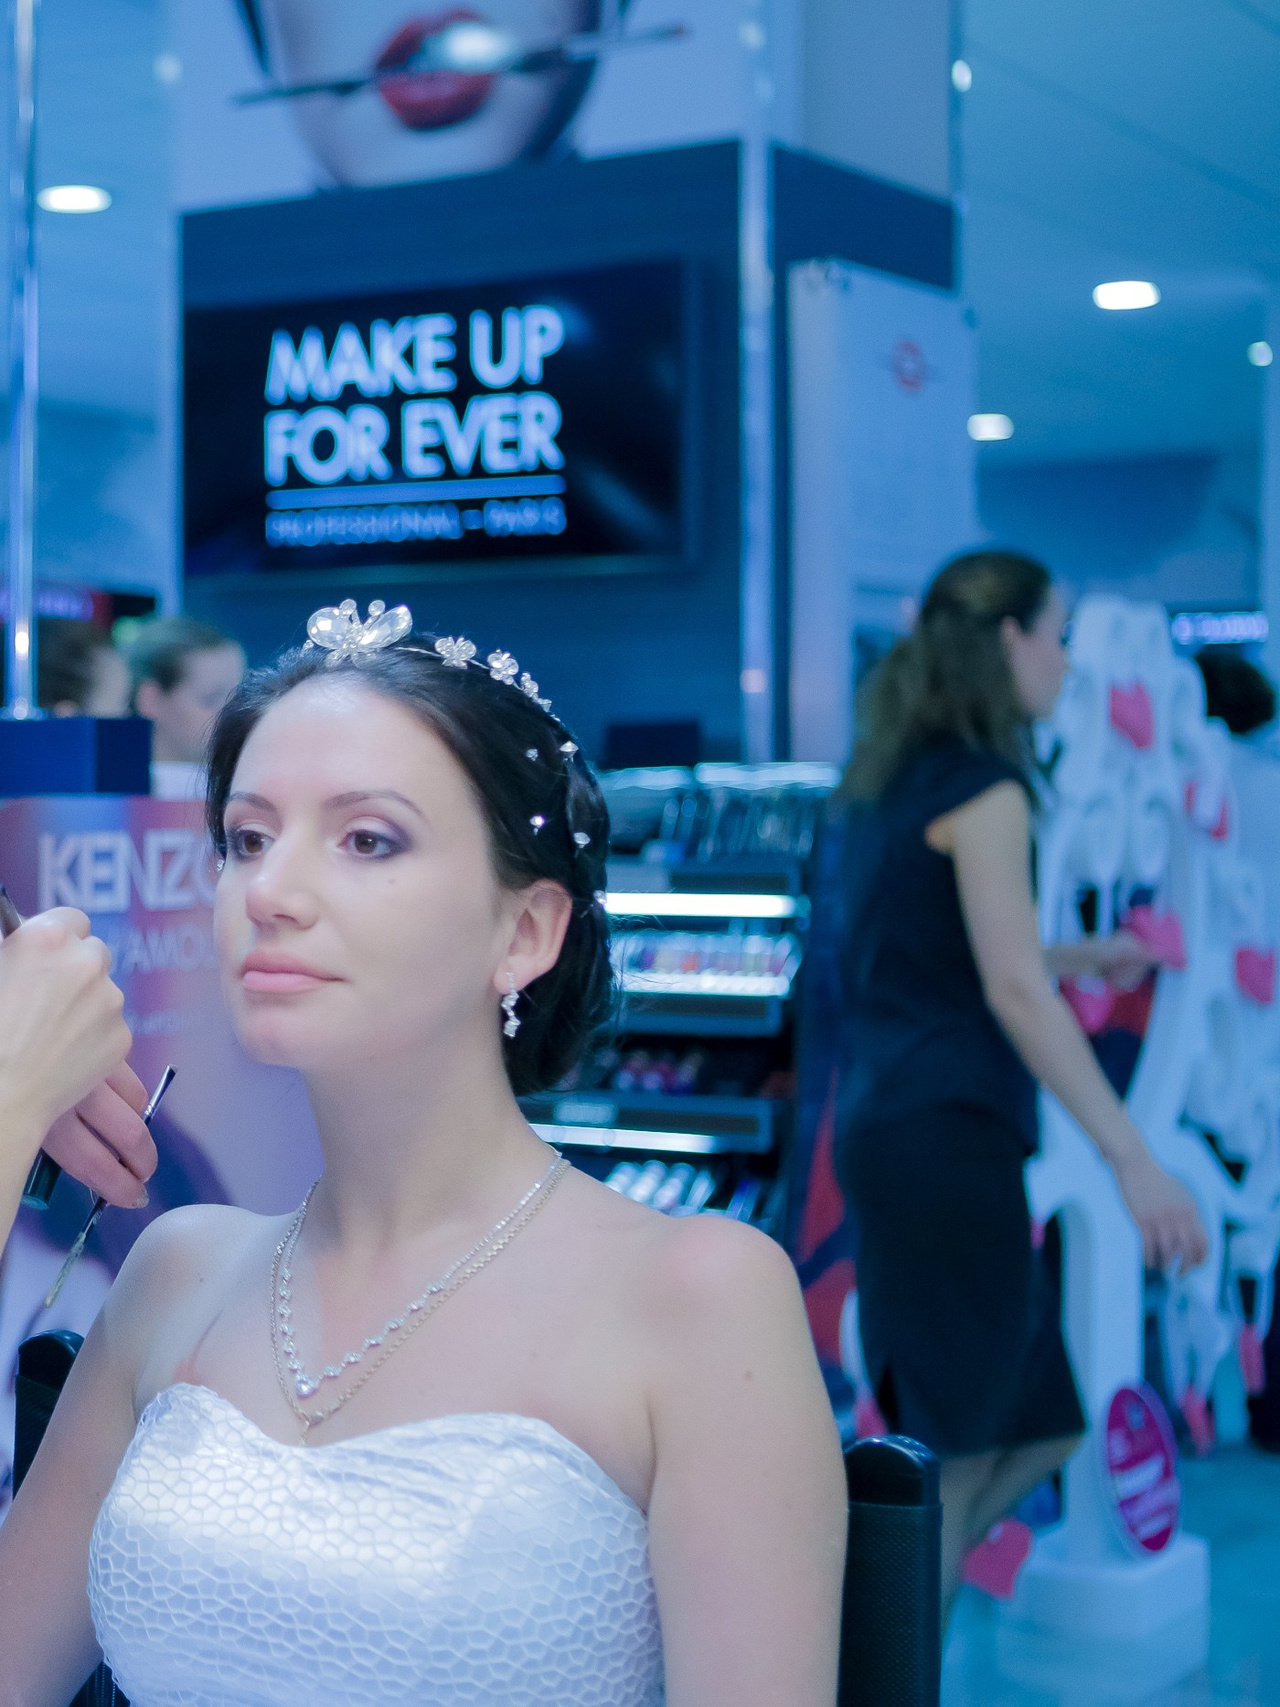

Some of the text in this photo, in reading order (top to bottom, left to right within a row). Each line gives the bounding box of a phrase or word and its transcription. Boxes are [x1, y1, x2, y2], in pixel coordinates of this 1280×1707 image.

[265, 304, 565, 405] MAKE UP
[264, 391, 565, 487] FOR EVER
